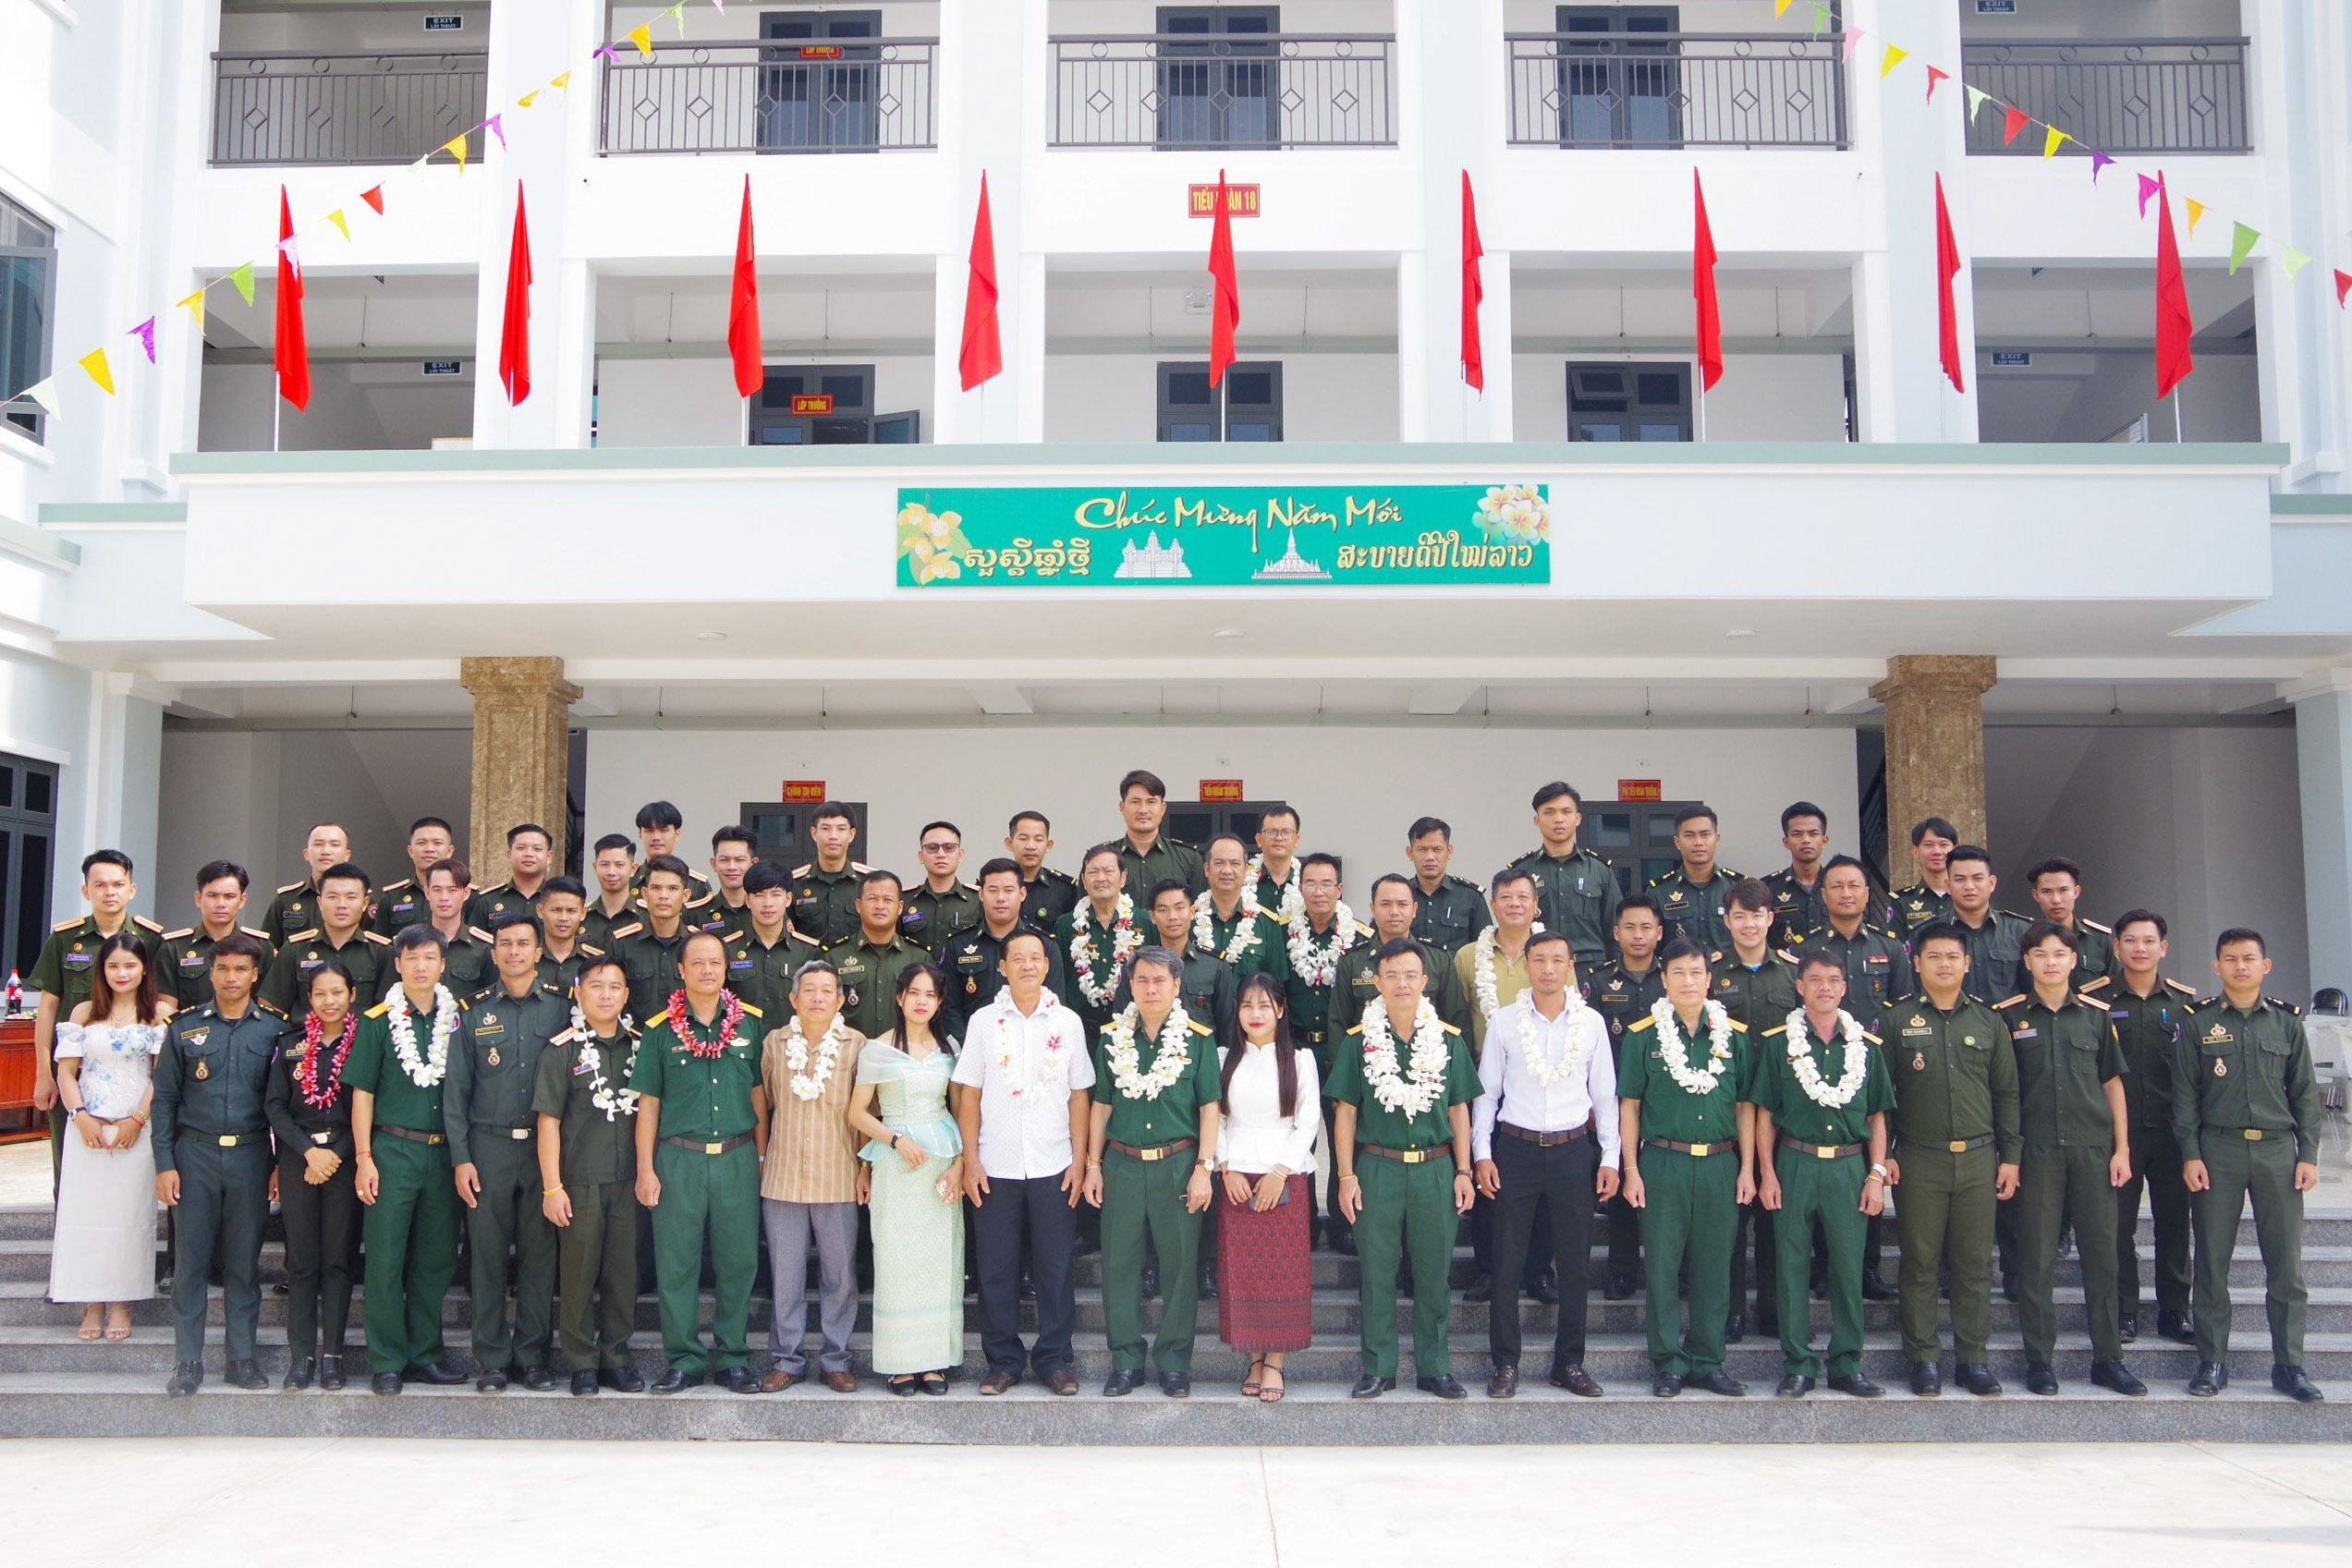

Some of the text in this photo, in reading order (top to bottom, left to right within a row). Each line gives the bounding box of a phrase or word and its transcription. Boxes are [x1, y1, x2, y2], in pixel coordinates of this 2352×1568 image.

[1193, 186, 1214, 211] TIỂU
[1244, 190, 1257, 211] 18
[1074, 490, 1403, 553] Chúc Mừng Năm Mới
